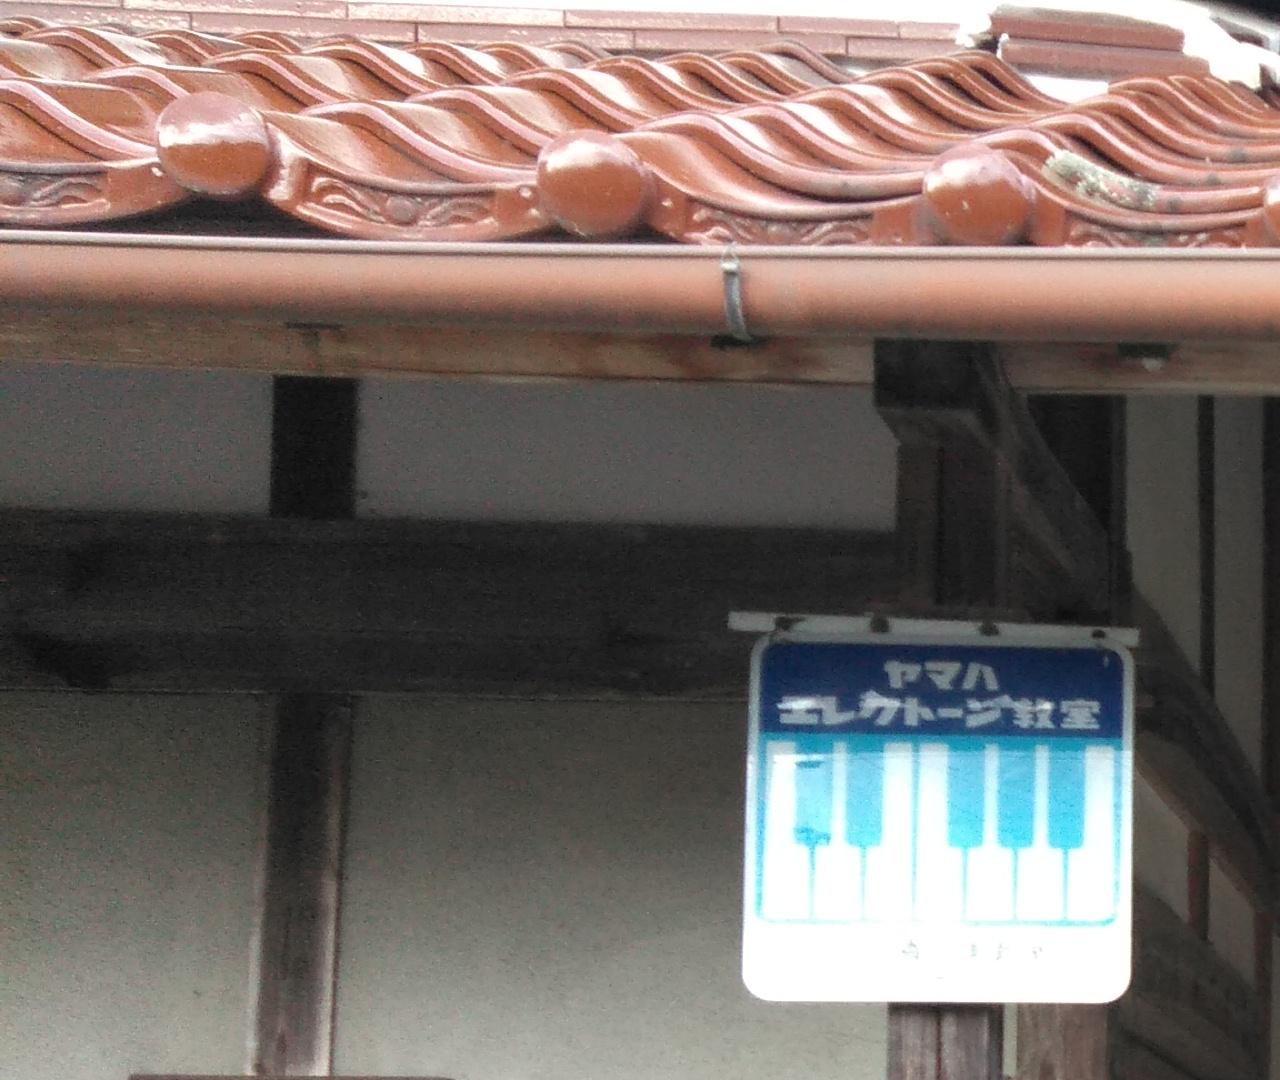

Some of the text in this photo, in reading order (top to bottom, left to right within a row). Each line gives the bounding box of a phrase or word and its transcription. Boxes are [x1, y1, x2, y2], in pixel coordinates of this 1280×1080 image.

[883, 660, 999, 691] ヤマハ
[776, 690, 1101, 730] エレクトーン教室
